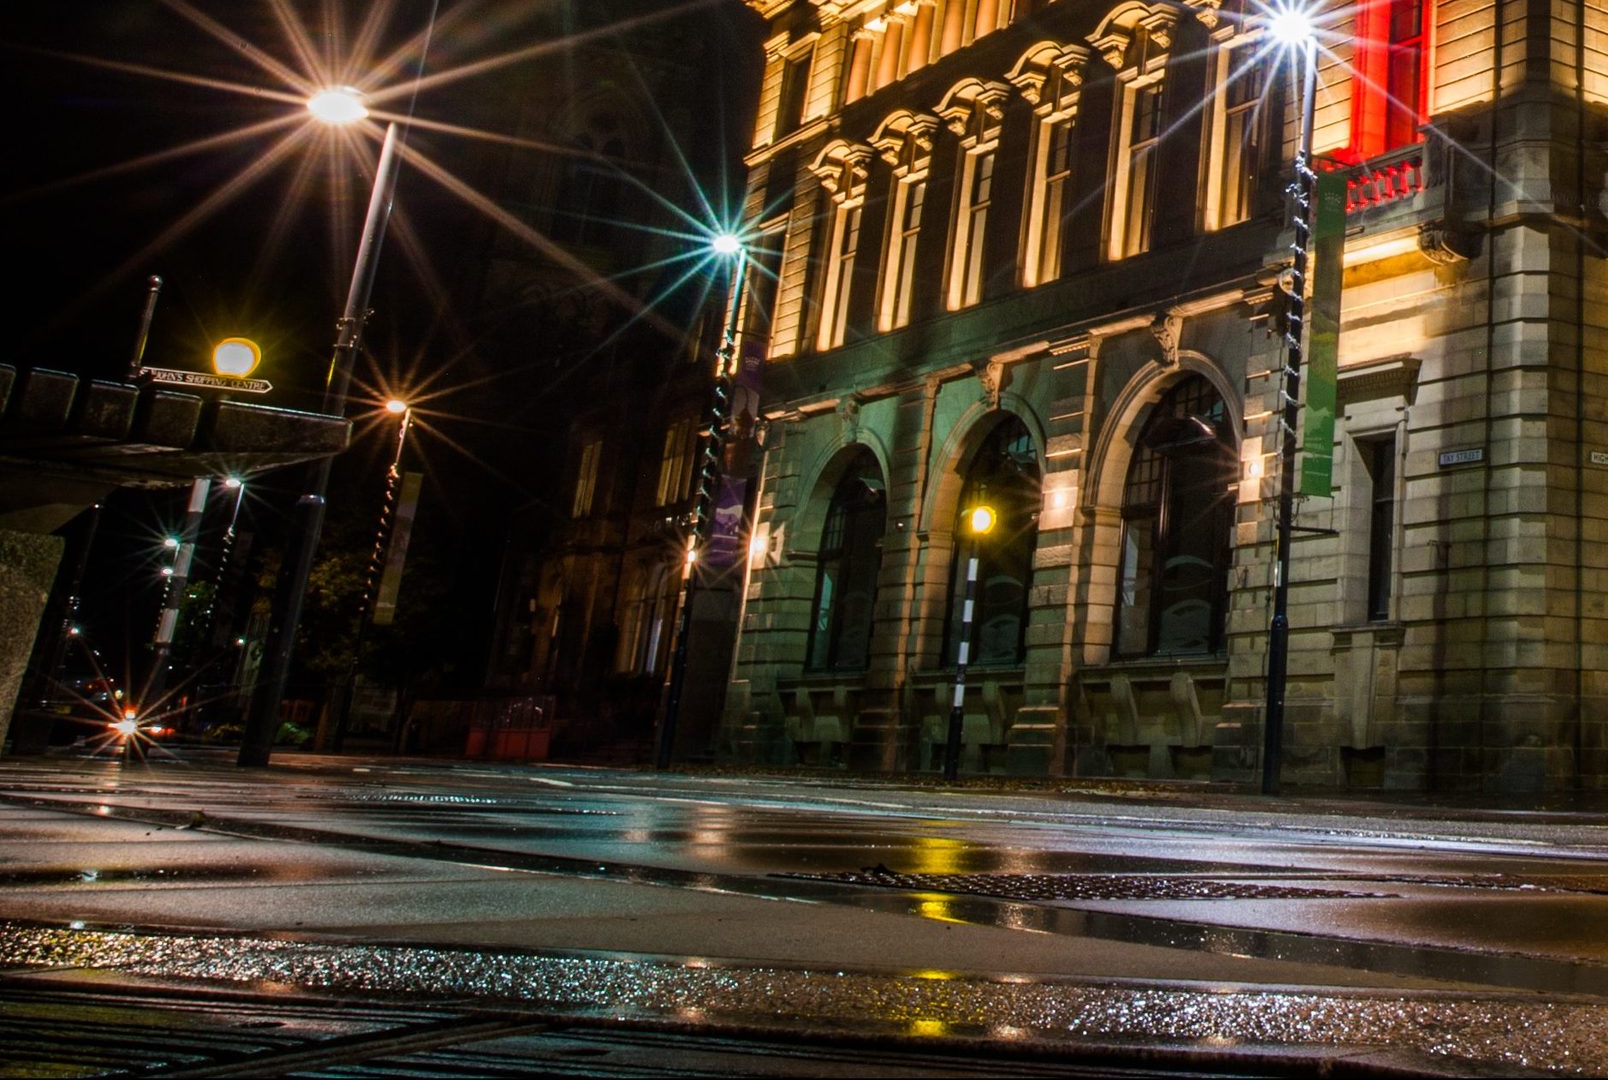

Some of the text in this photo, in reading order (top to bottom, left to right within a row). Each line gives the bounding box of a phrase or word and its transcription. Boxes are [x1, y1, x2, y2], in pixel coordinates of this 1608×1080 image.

[231, 379, 266, 391] CENTRE
[1455, 450, 1480, 461] STREET
[1593, 454, 1608, 463] HIGH
